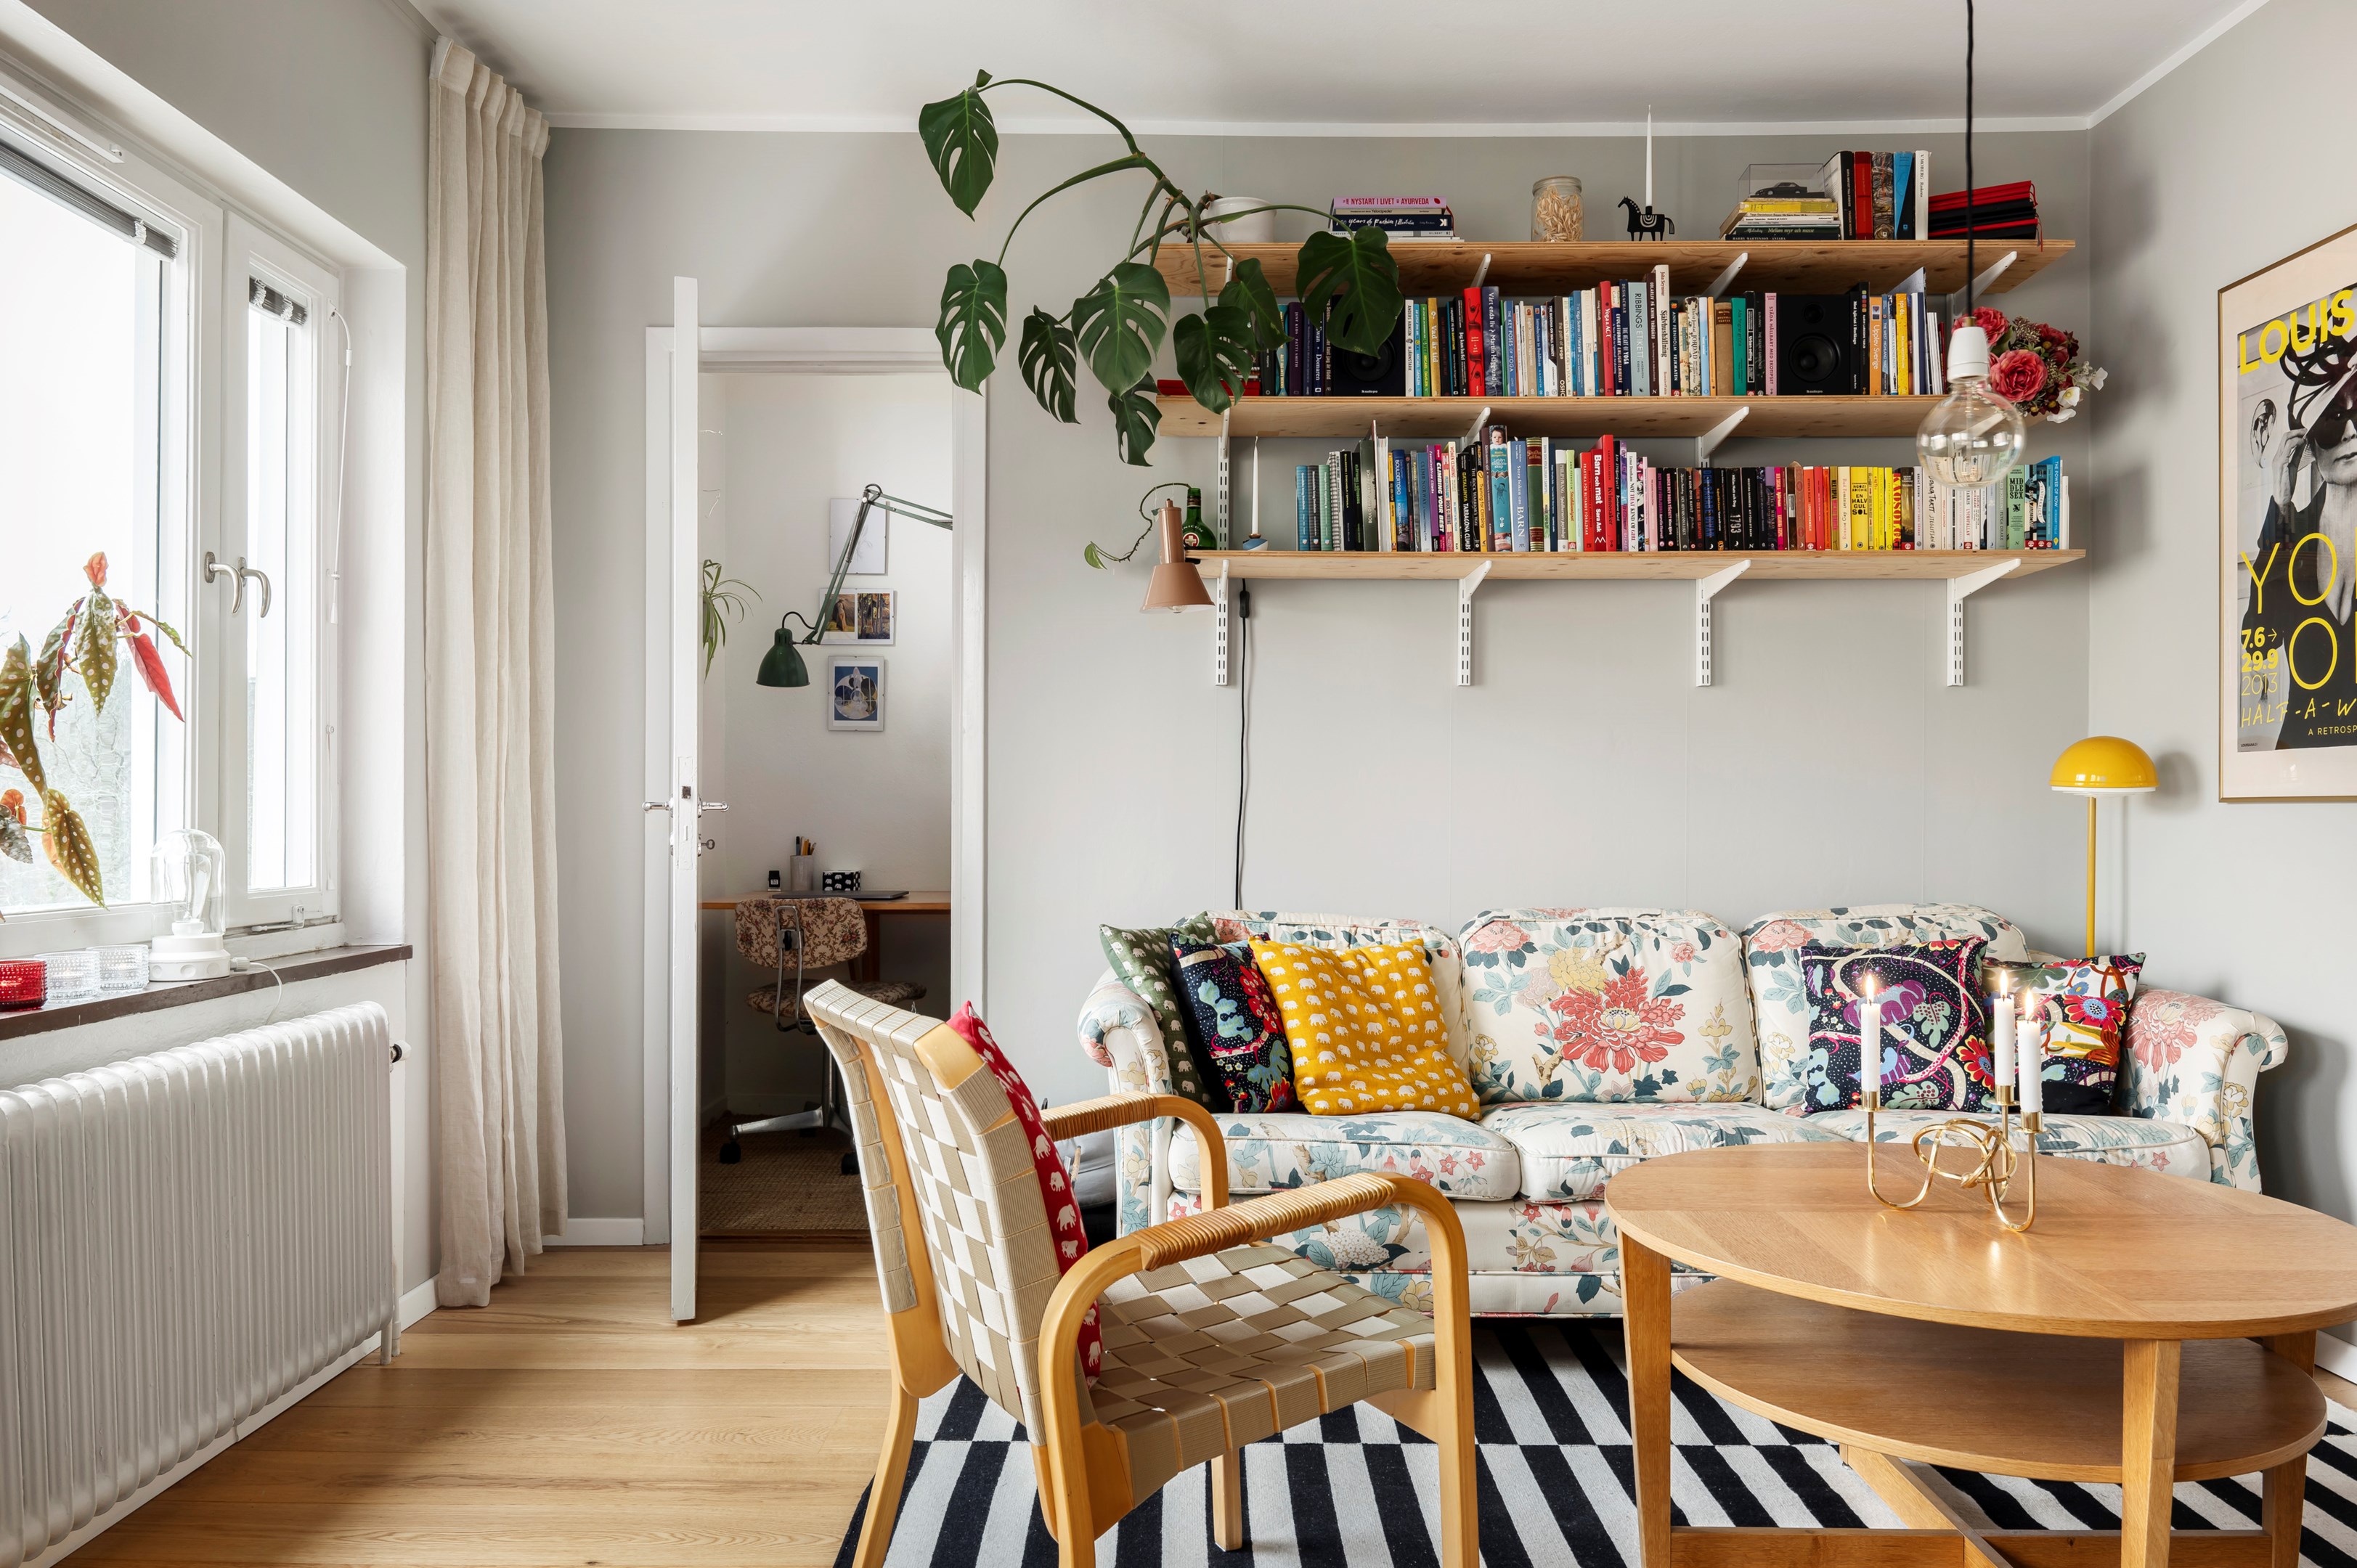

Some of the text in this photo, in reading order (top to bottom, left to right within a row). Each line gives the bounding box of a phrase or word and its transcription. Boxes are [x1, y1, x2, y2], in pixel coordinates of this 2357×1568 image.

[1872, 348, 1881, 369] Sverige
[1730, 514, 1741, 534] 1793
[2240, 533, 2357, 614] YO
[2241, 626, 2266, 649] 7.6
[2241, 648, 2279, 673] 29.9
[2241, 671, 2279, 697] 2013
